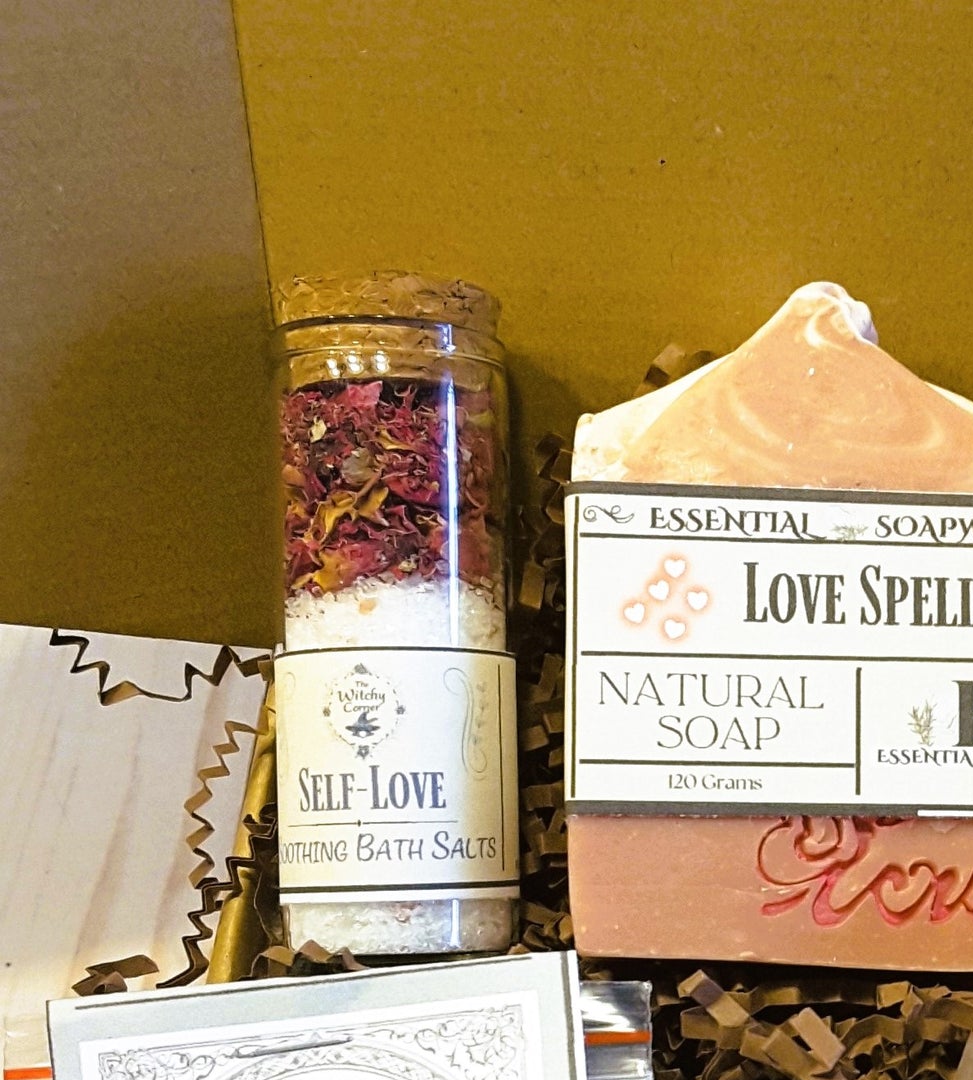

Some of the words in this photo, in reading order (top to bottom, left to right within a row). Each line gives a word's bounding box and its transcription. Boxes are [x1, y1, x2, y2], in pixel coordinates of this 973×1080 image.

[649, 506, 827, 542] ESSENTIAL
[337, 687, 386, 706] Witchy
[597, 671, 825, 710] NATURAL
[343, 702, 380, 714] Corner
[656, 715, 781, 751] SOAP
[667, 773, 697, 790] 120
[701, 773, 764, 792] Grams
